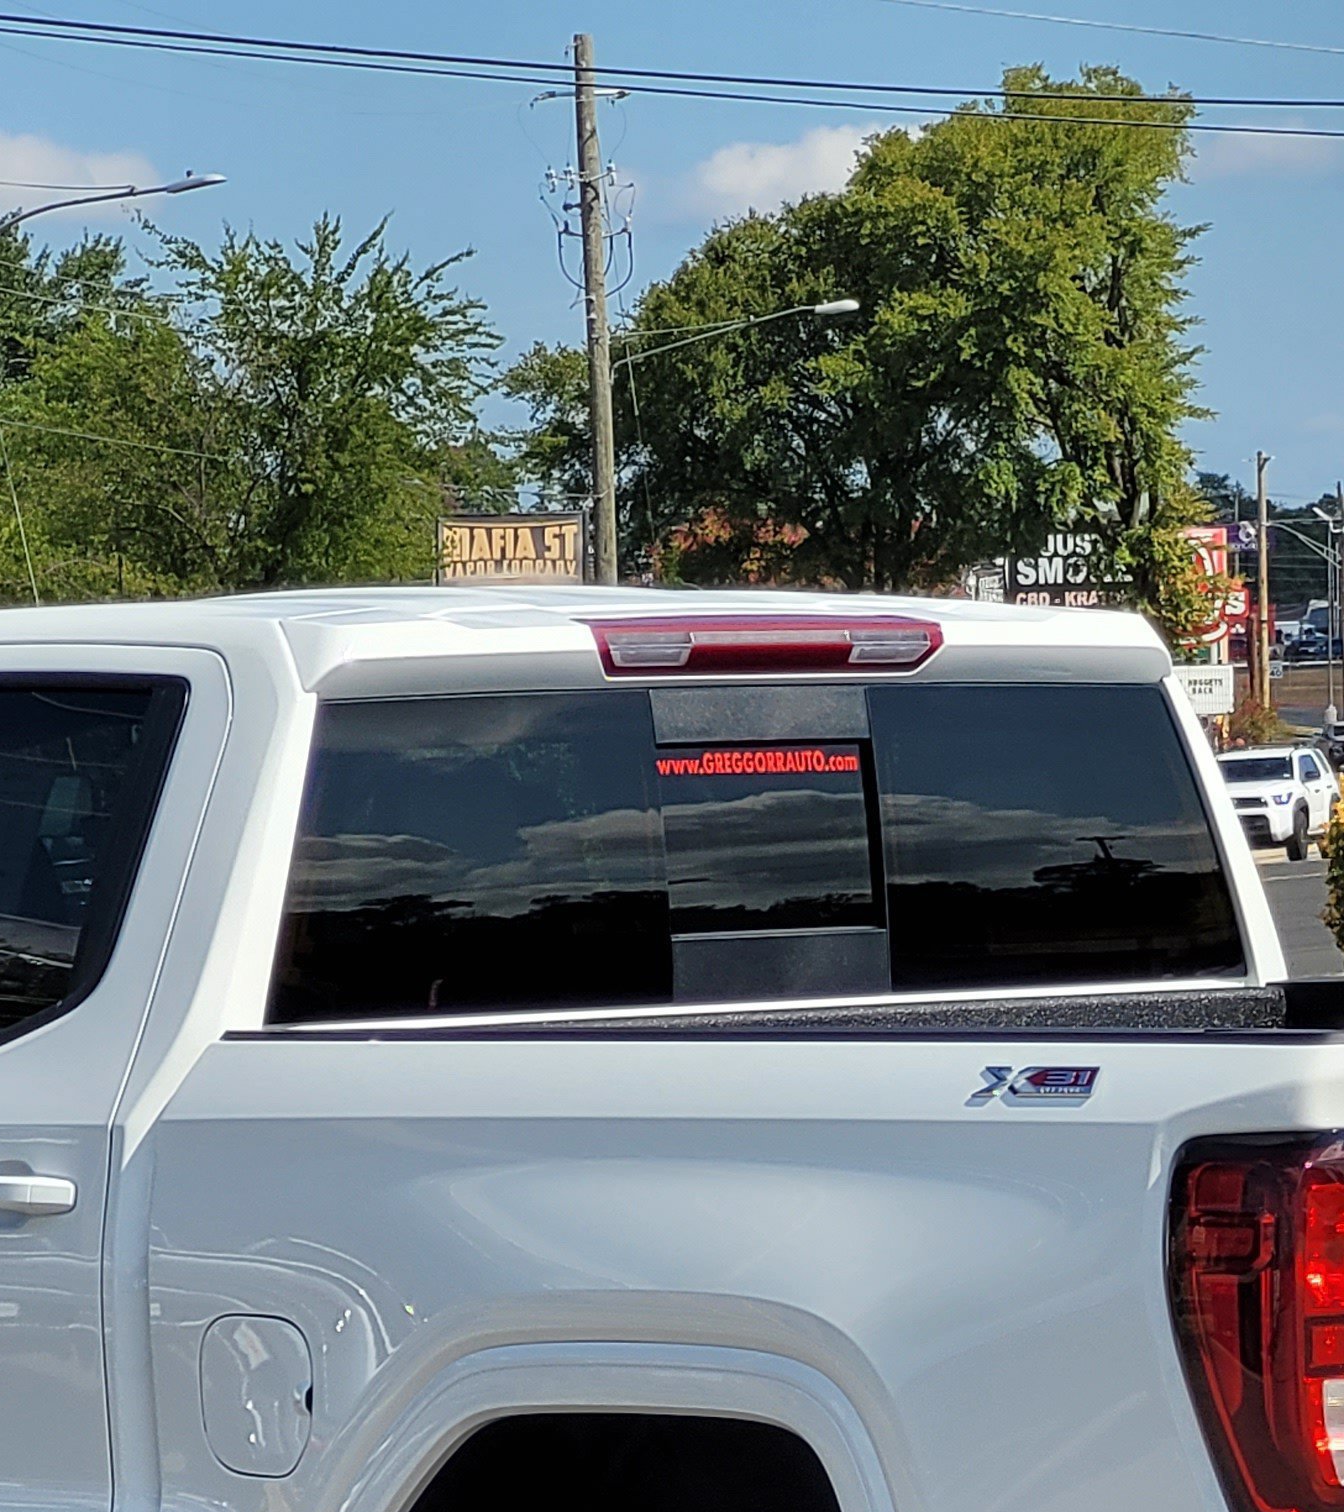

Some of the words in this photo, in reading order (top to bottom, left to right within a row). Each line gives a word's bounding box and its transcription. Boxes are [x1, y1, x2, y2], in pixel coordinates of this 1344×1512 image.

[443, 526, 537, 562] MAFIA
[544, 524, 578, 561] ST
[656, 750, 858, 775] www.GREGGORRAUTO.com
